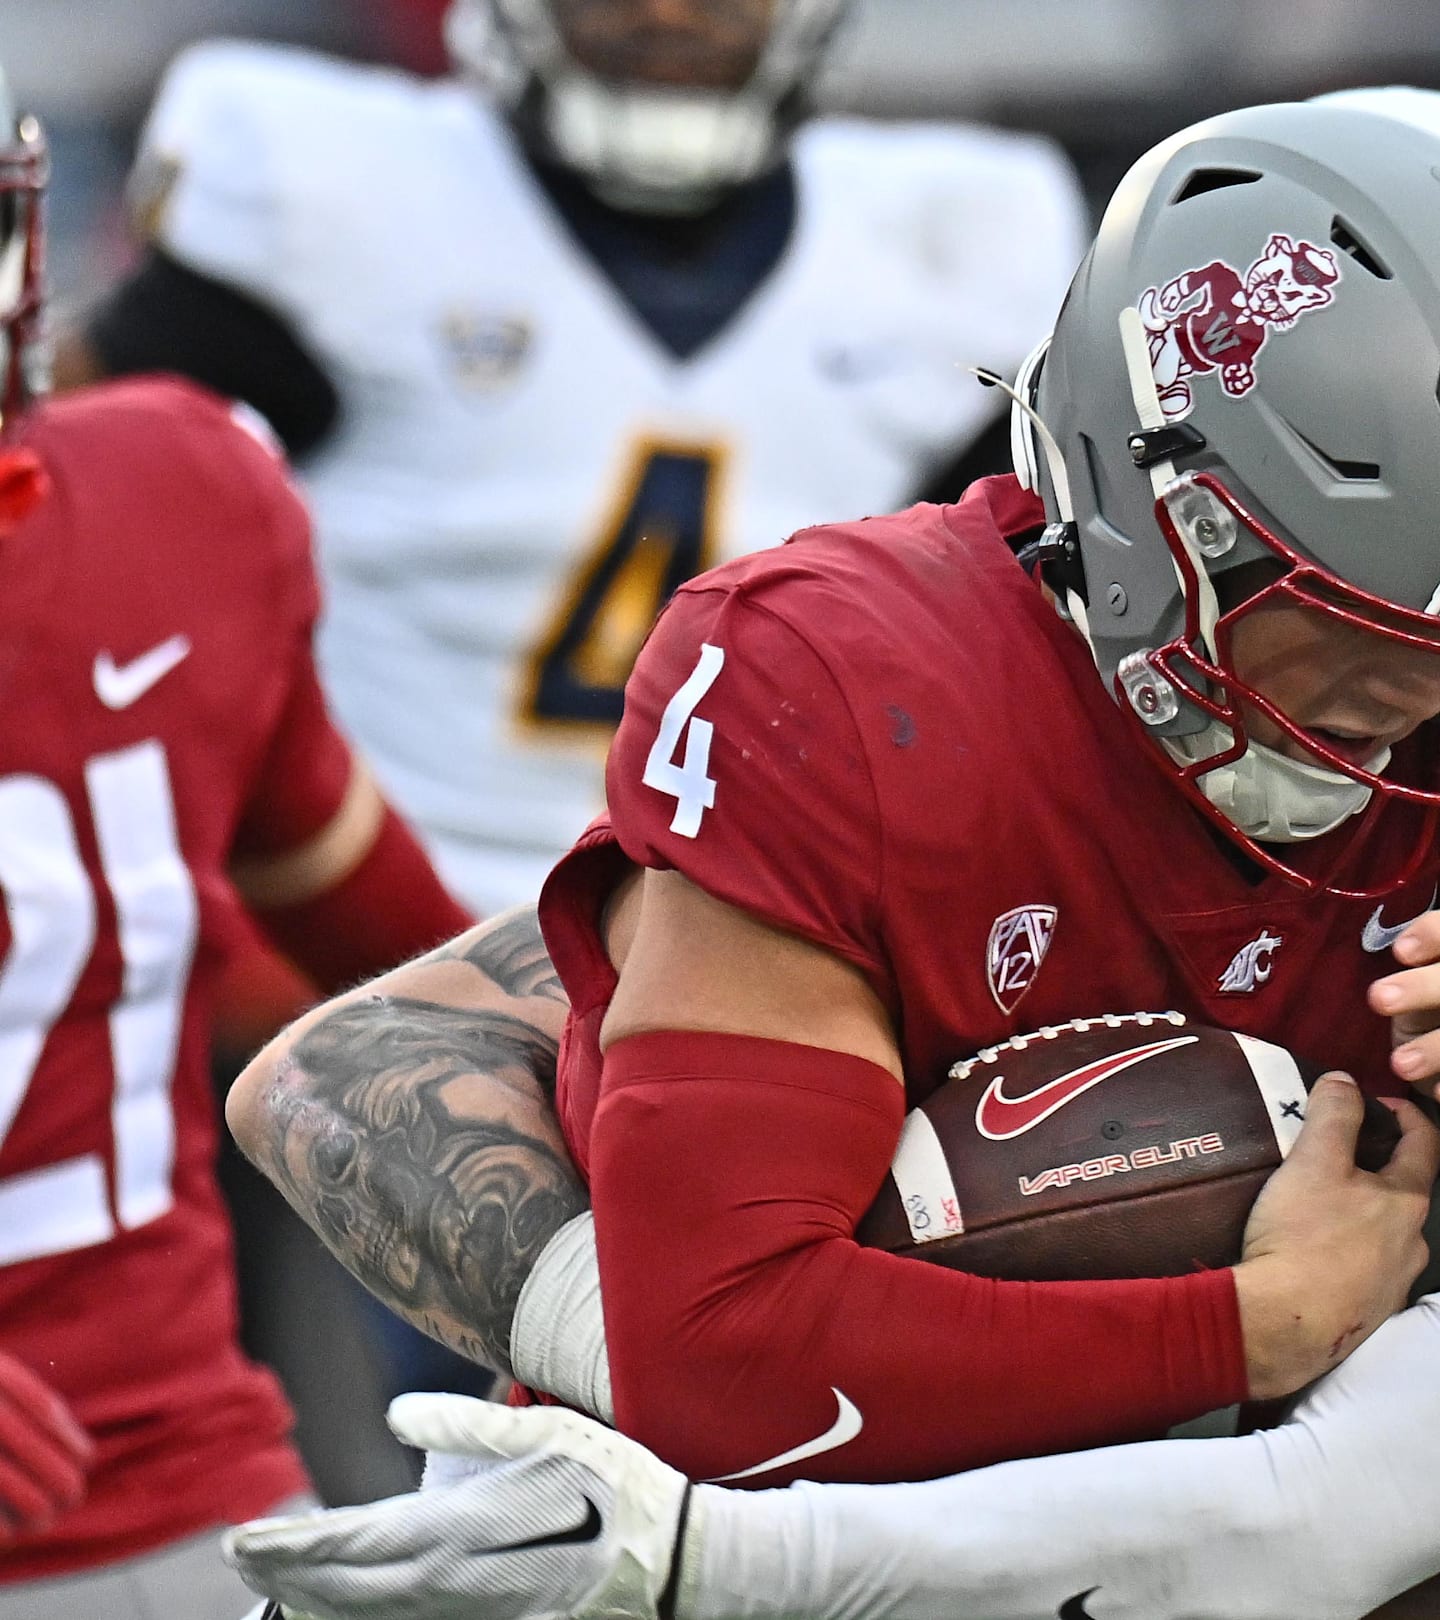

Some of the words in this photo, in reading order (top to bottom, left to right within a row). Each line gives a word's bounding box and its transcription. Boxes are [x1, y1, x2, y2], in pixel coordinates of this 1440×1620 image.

[1202, 310, 1241, 356] W
[513, 432, 730, 742] 4
[641, 642, 725, 840] 4
[992, 909, 1055, 976] PAC
[998, 951, 1034, 994] 12
[0, 737, 198, 1267] 21
[1018, 1154, 1131, 1196] VAPOR
[1129, 1132, 1225, 1170] ELITE
